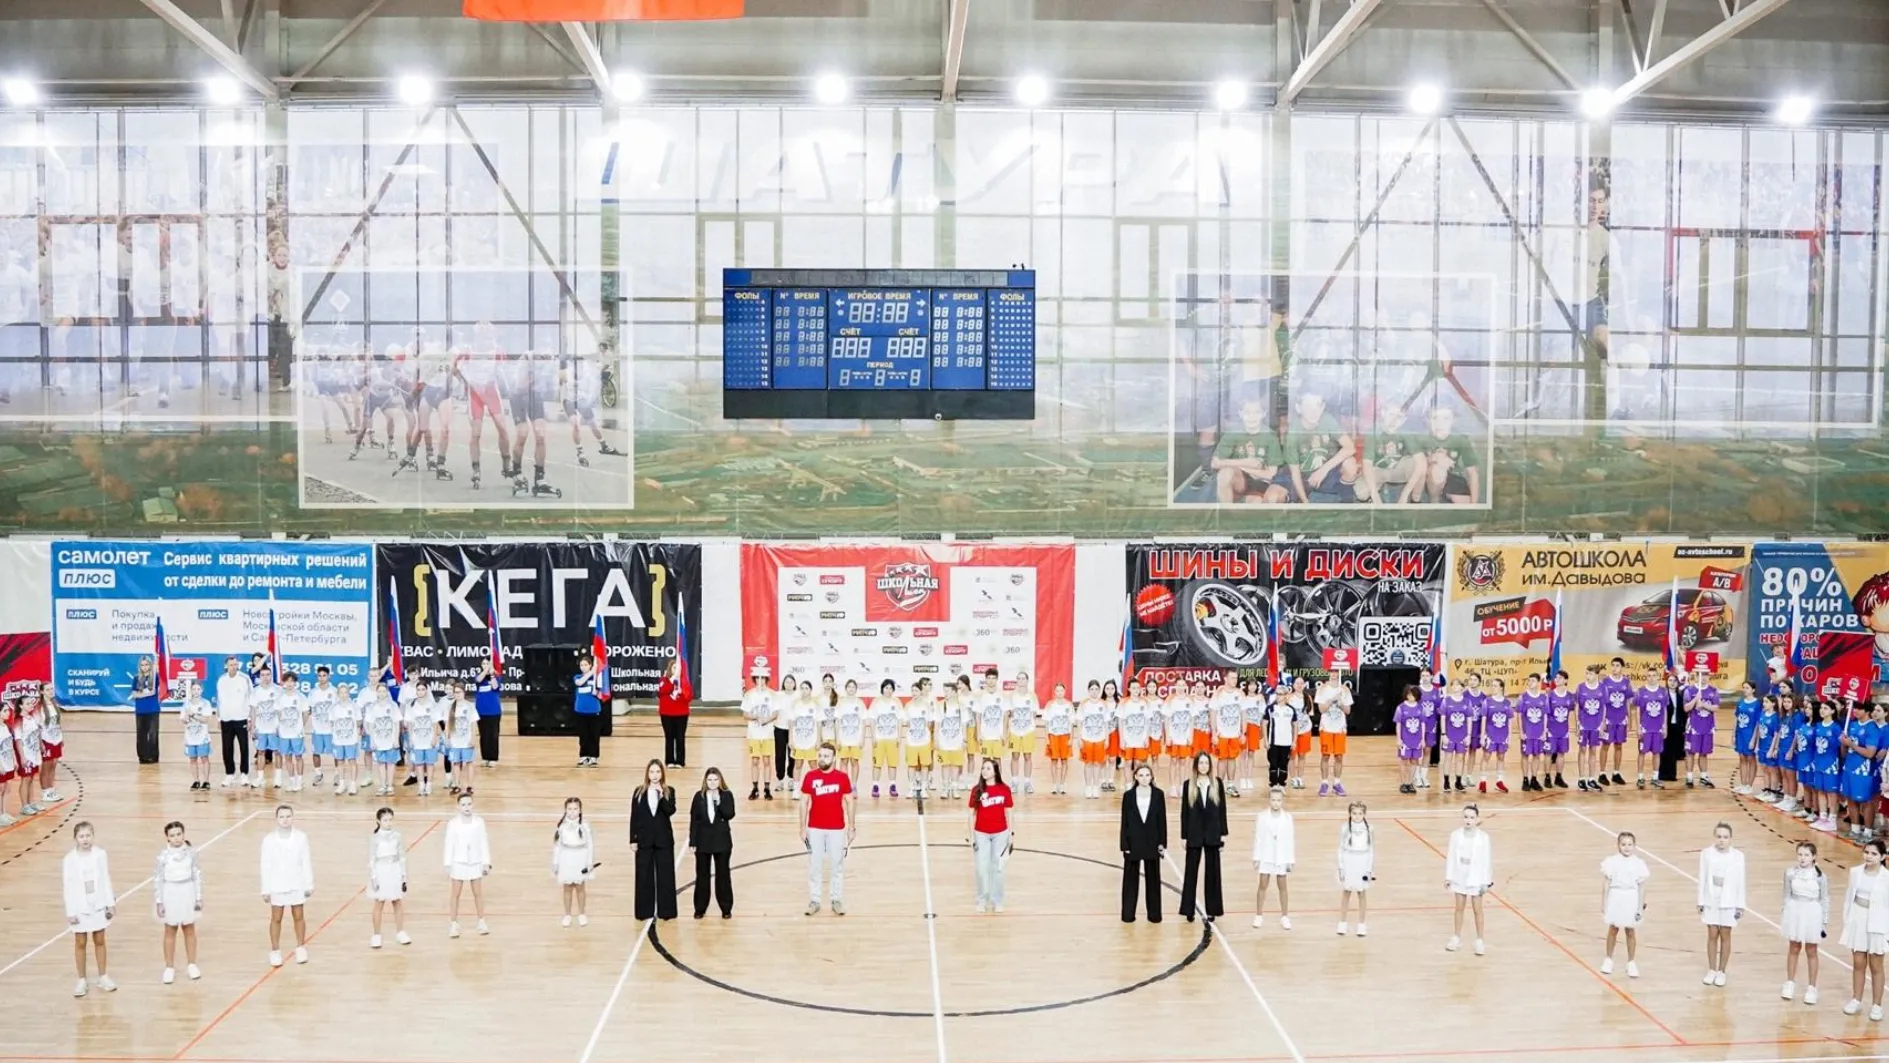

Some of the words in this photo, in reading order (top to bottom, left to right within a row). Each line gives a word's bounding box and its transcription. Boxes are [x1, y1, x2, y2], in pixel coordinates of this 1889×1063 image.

[735, 292, 760, 300] ФОЛЫ
[795, 292, 820, 300] ВРЕМЯ
[848, 292, 882, 300] ИГРОВОЕ
[885, 292, 911, 300] ВРЕМЯ
[953, 292, 979, 301] ВРЕМЯ
[1000, 293, 1025, 301] ФОЛЫ
[867, 361, 894, 369] ПЕРИОД
[58, 550, 152, 565] самолет
[163, 551, 212, 568] Сервис
[219, 552, 299, 569] квартирных
[306, 552, 367, 570] решений
[1521, 550, 1647, 570] АВТОШКОЛА
[1149, 549, 1258, 580] ШИНЫ
[1269, 549, 1295, 580] И
[1304, 549, 1425, 582] ДИСКИ
[164, 576, 178, 587] от
[181, 575, 227, 590] сделки
[229, 576, 244, 589] до
[248, 576, 303, 591] ремонта
[306, 577, 314, 587] и
[317, 574, 367, 590] мебели
[876, 576, 940, 590] ШКОЛЬНАЯ
[1378, 581, 1391, 593] НА
[1393, 581, 1423, 594] ЗАКАЗ
[1761, 566, 1843, 598] 80%
[112, 609, 155, 620] Покупка
[1476, 601, 1521, 616] ОБУЧЕНИЕ
[312, 609, 358, 621] Москвы,
[308, 622, 349, 634] области
[1496, 614, 1540, 636] 5000
[1474, 658, 1508, 667] Шатура,
[67, 667, 110, 676] СКАНИРУЙ
[336, 663, 359, 676] 05
[421, 667, 458, 679] Ильича
[611, 668, 661, 678] Школьная
[77, 678, 97, 687] БУДЬ
[77, 687, 100, 697] КУРСЕ
